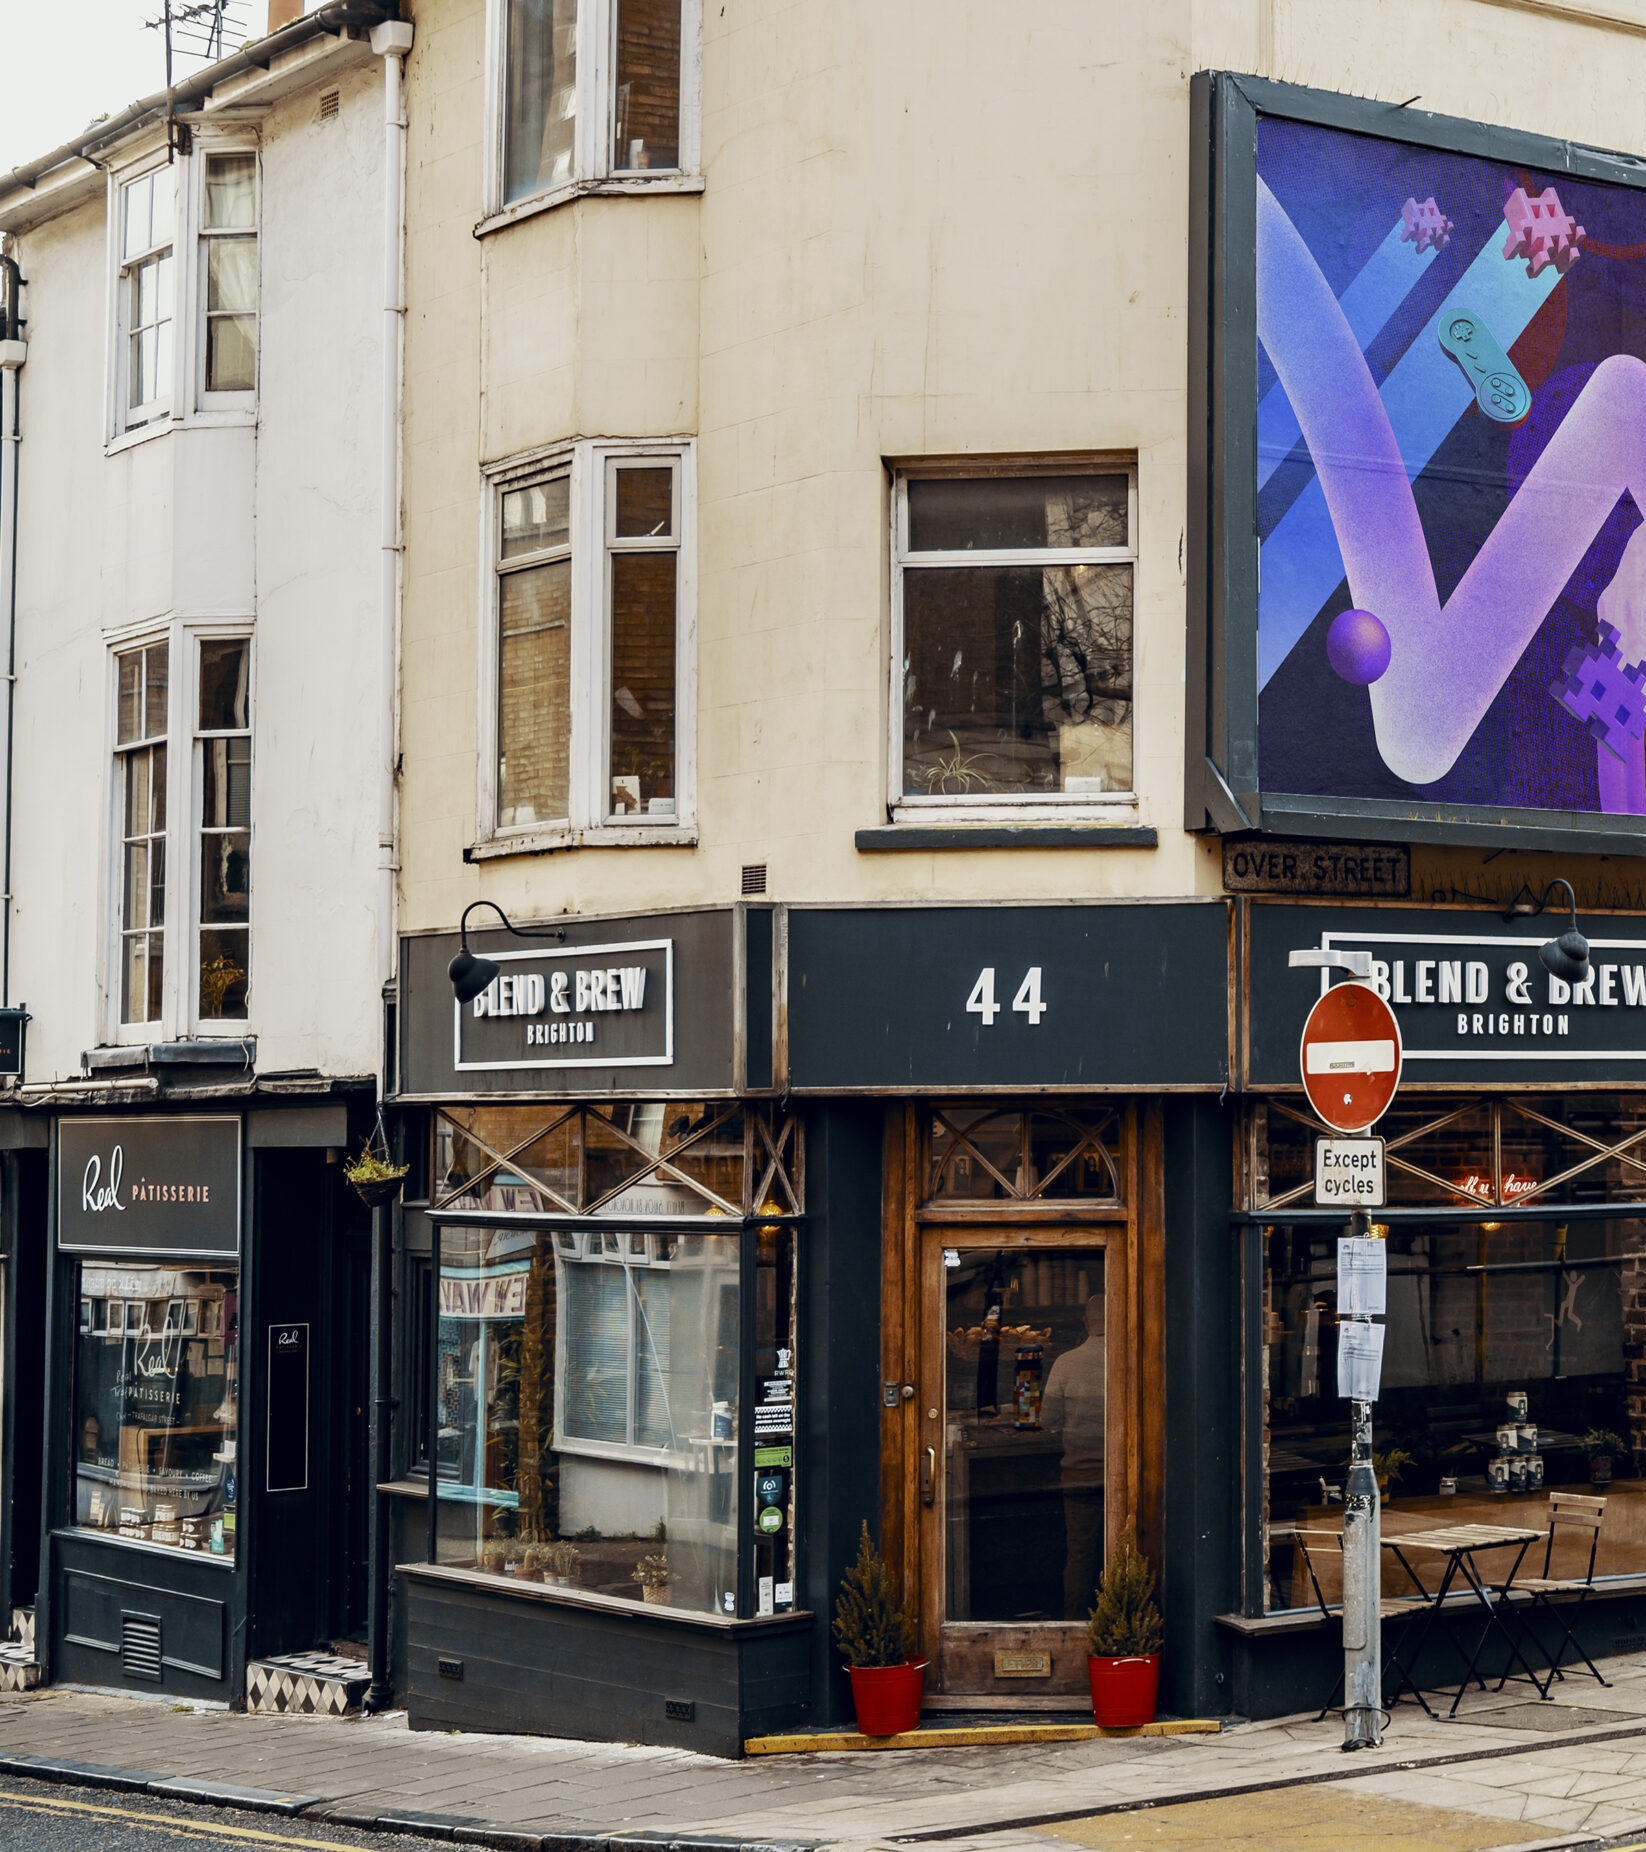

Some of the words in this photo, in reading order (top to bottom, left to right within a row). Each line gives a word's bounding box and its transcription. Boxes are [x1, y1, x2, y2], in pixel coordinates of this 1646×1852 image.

[1233, 852, 1297, 879] OVER
[1313, 855, 1401, 883] STREET
[550, 971, 571, 1013] &
[575, 966, 646, 1012] BREW
[966, 967, 1046, 1025] 44
[1371, 960, 1489, 1004] BLEND
[1506, 961, 1533, 1005] &
[527, 1022, 594, 1045] BRIGHTON
[1457, 1013, 1569, 1035] BRIGHTON
[1323, 1149, 1377, 1171] Except
[83, 1144, 126, 1212] Real
[132, 1176, 210, 1203] PÂTISSERIE
[1324, 1175, 1374, 1196] cycles
[1504, 1174, 1538, 1193] have
[134, 1316, 178, 1379] Real
